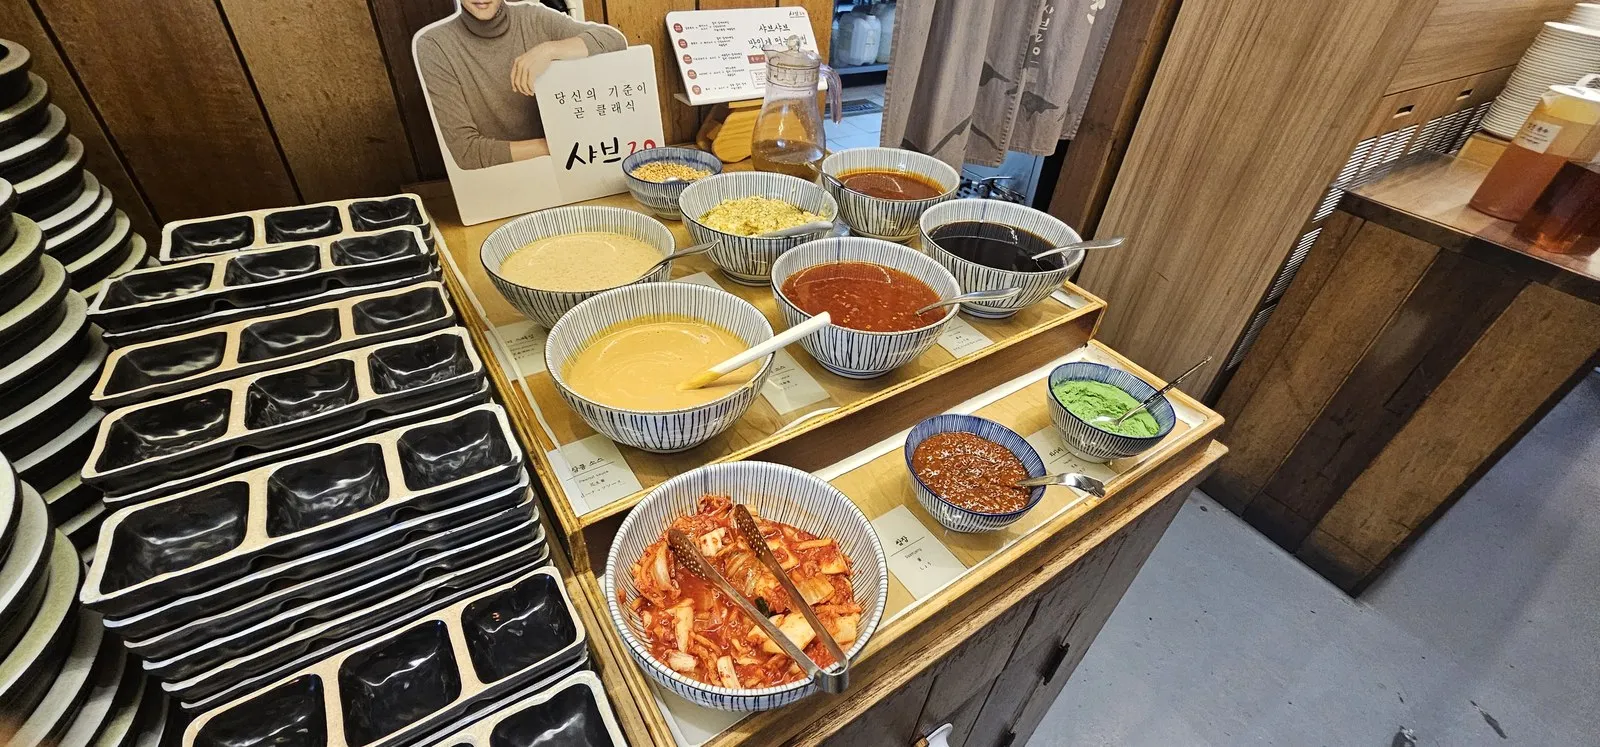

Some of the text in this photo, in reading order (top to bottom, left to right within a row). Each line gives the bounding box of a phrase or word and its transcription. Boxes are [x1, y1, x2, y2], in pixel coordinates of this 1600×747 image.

[759, 22, 791, 33] 샤브샤브
[554, 81, 648, 105] 당신의 기준이
[573, 99, 636, 119] 곧 클래식
[589, 457, 605, 466] 소스
